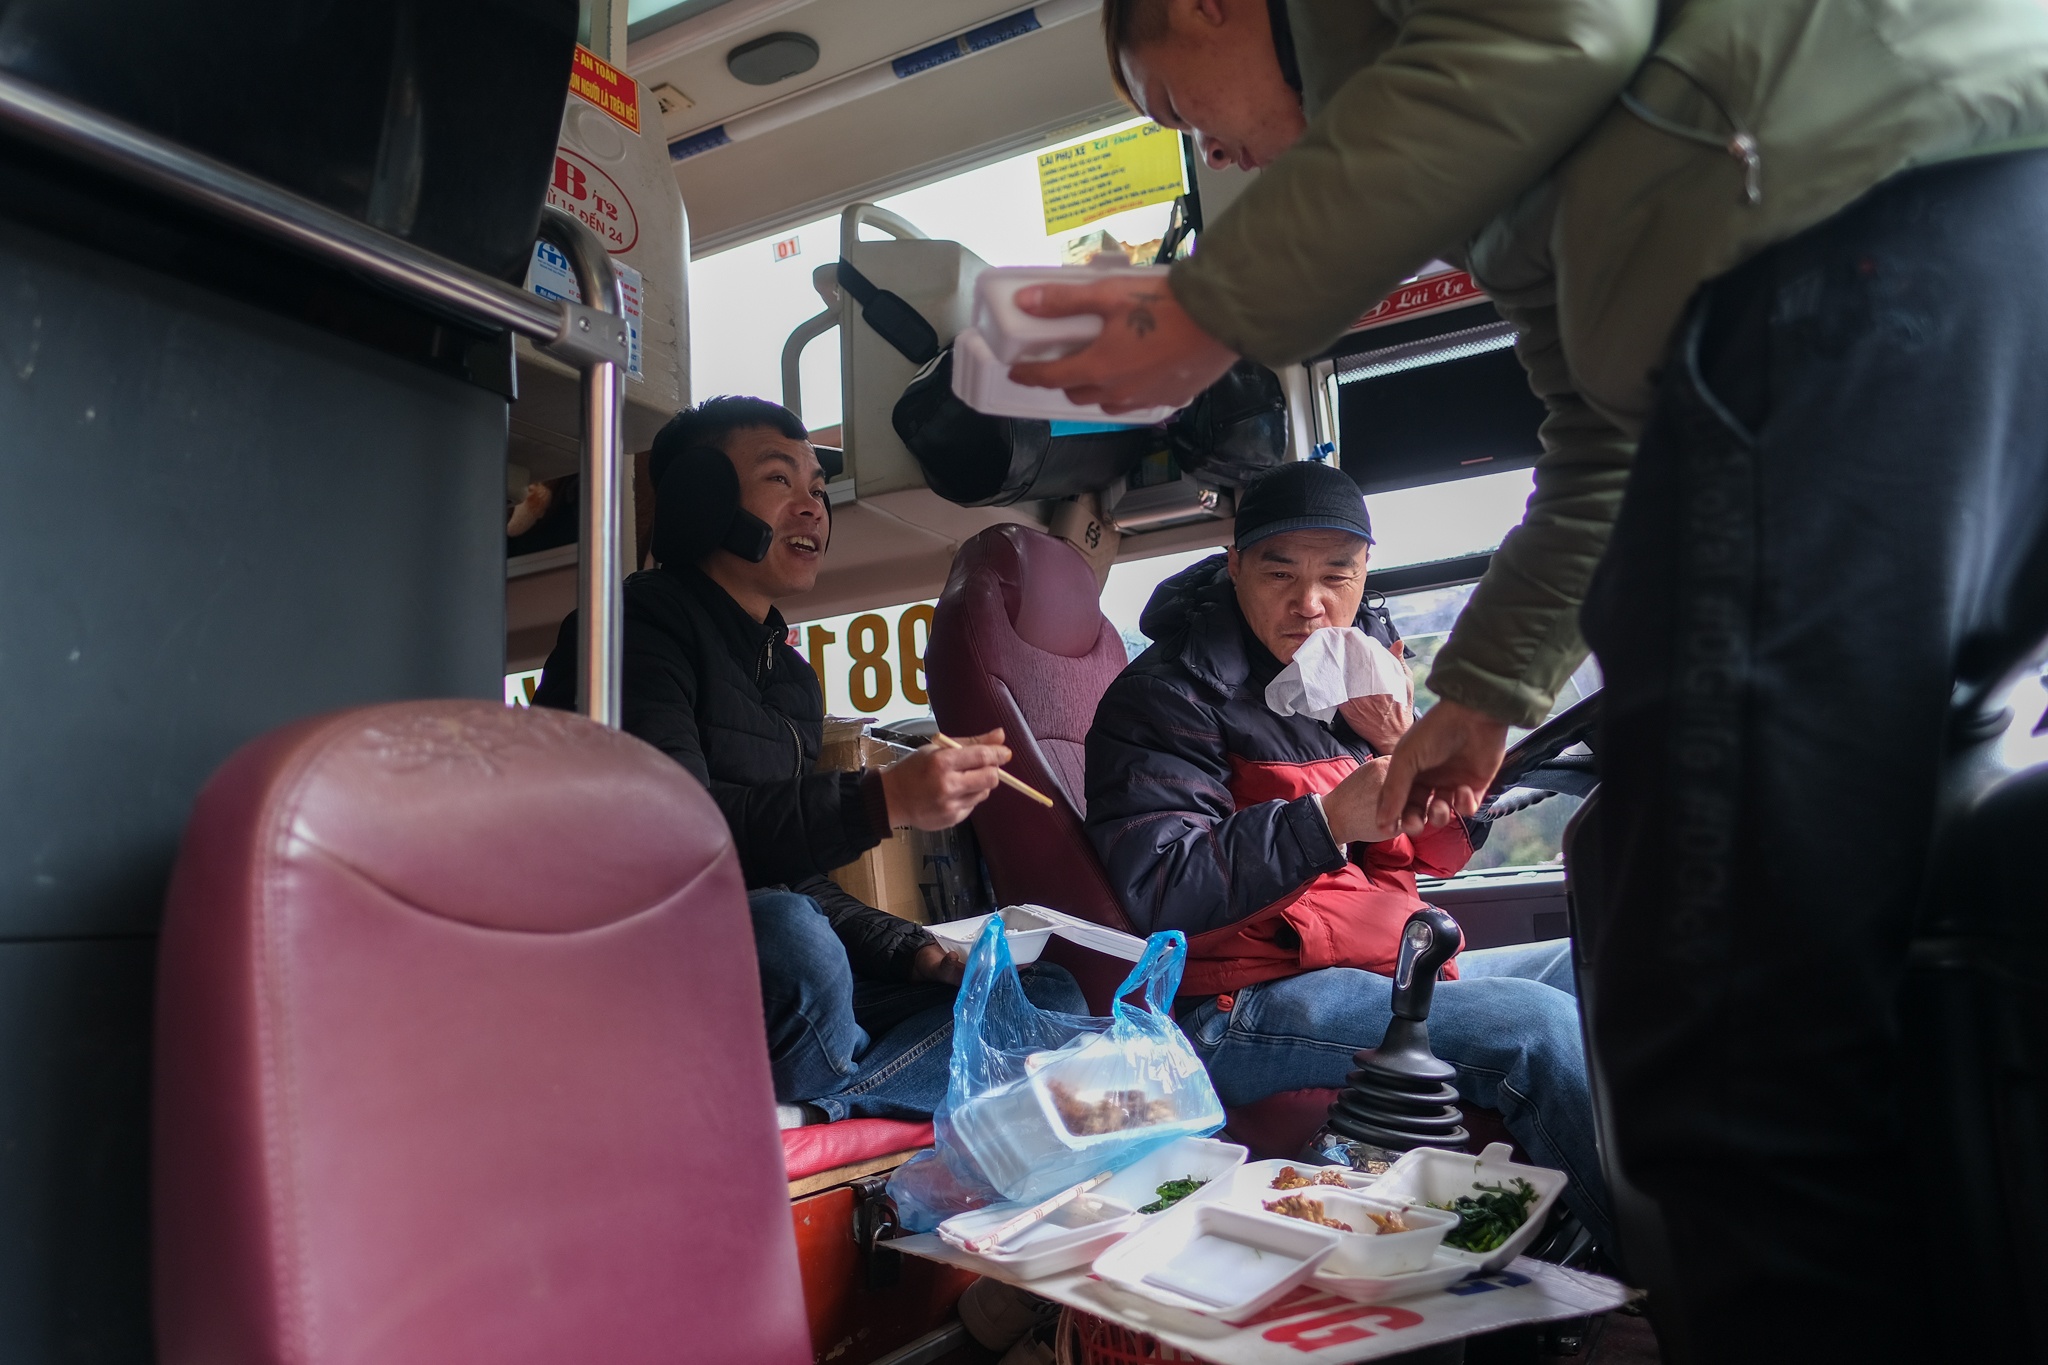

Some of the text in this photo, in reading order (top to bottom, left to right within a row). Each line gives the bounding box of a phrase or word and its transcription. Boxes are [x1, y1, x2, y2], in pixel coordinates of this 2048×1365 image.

[581, 52, 594, 71] AN
[595, 61, 617, 86] TOÀN
[601, 88, 608, 108] LÀ
[609, 96, 625, 117] TRÊN
[625, 103, 637, 124] HẾT
[1076, 146, 1086, 156] XE
[561, 200, 575, 214] 18
[579, 210, 605, 234] ĐẾN
[609, 227, 623, 244] 24
[777, 239, 796, 258] 01
[1435, 279, 1464, 299] Xe
